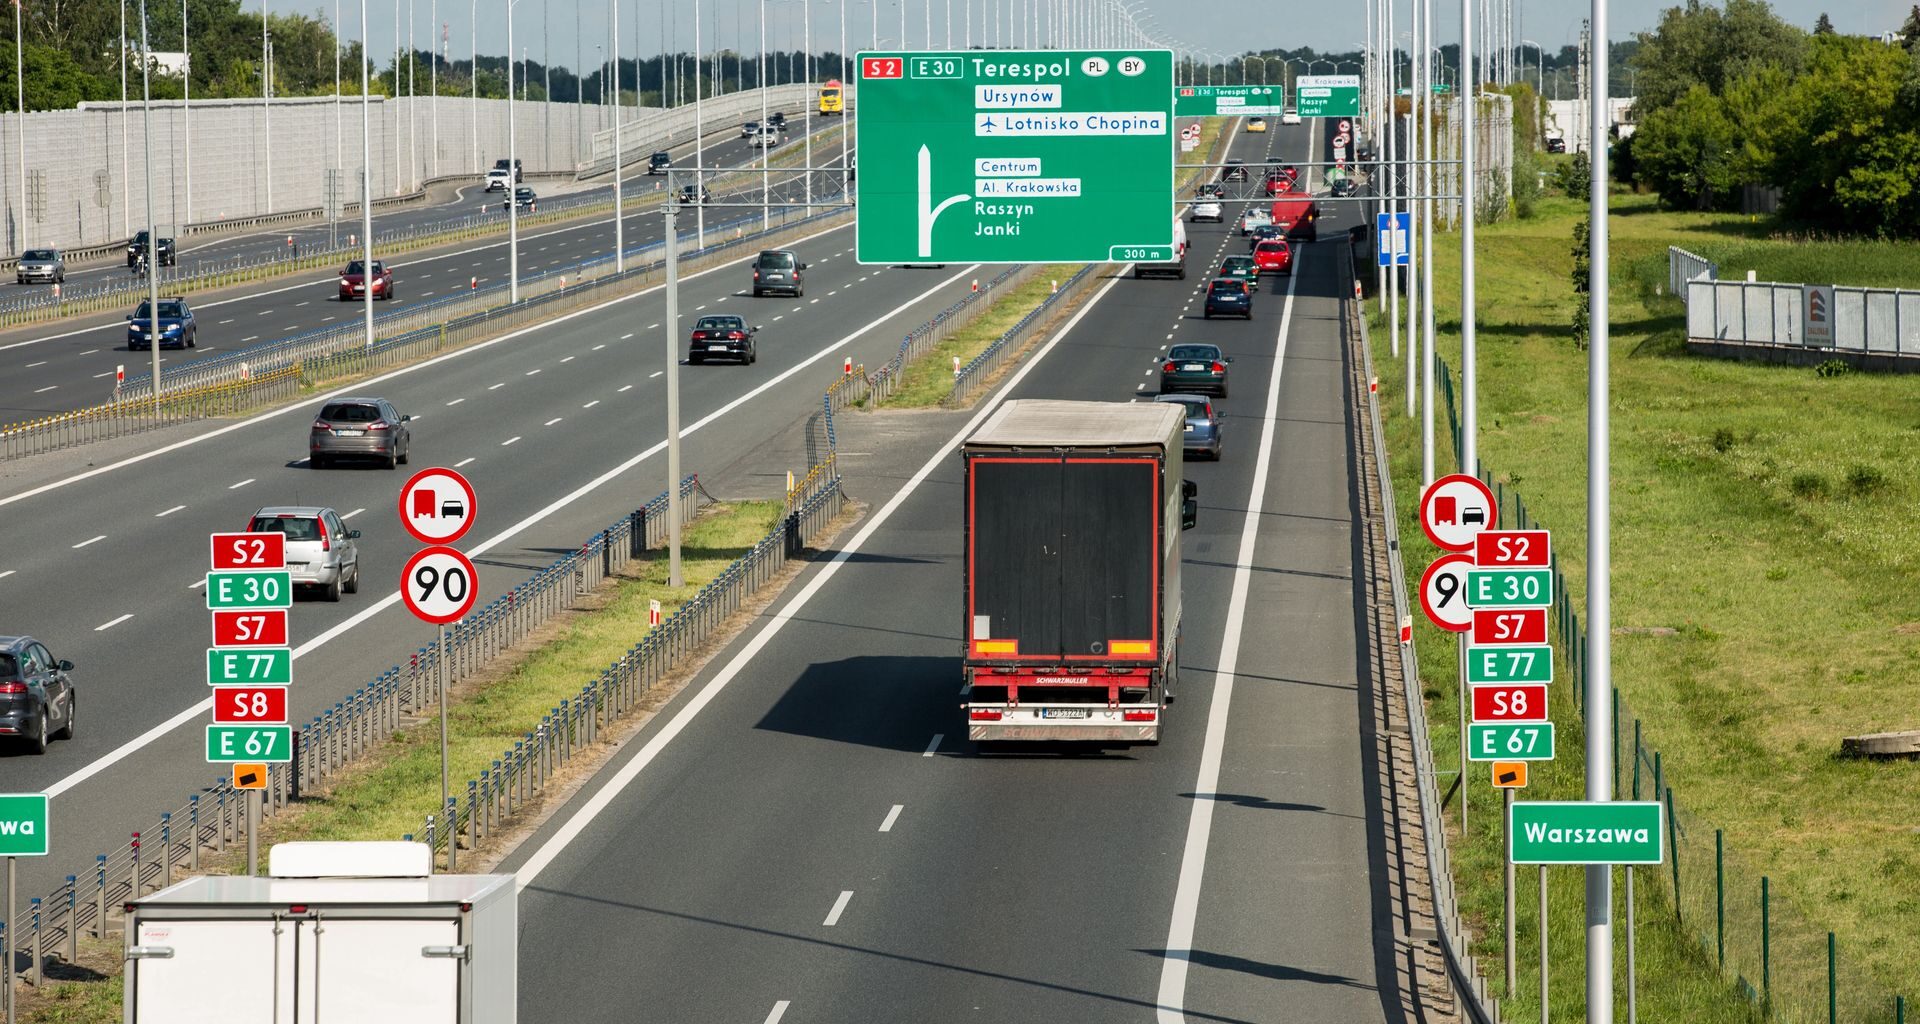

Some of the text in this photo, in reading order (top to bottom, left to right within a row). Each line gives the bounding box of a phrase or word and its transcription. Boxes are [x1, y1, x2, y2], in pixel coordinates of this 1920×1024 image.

[920, 60, 954, 75] E 30
[971, 57, 1070, 81] Terespol
[1089, 62, 1102, 72] PL
[1125, 62, 1139, 71] BY
[984, 88, 1053, 106] Ursynów
[1216, 88, 1249, 97] Terespol
[1301, 98, 1328, 107] Raszyn
[1301, 107, 1321, 115] Janki
[1006, 116, 1159, 133] Lotnisko Chopina
[982, 162, 1037, 172] Centrum
[983, 182, 1077, 192] Al. Krakowska
[975, 202, 1033, 218] Raszyn
[975, 222, 1019, 235] Janki
[1125, 249, 1145, 258] 300
[233, 540, 265, 563] S2
[1496, 537, 1529, 561] S2
[219, 578, 279, 602] E 30
[416, 566, 466, 602] 90
[1479, 576, 1539, 600] E 30
[235, 616, 265, 640] S7
[1495, 614, 1525, 638] S7
[224, 654, 274, 678] E 77
[1484, 653, 1535, 677] E 77
[233, 692, 268, 717] S8
[1493, 690, 1527, 715] S8
[221, 731, 277, 755] E 67
[1483, 729, 1538, 753] E 67
[1525, 823, 1648, 843] Warszawa
